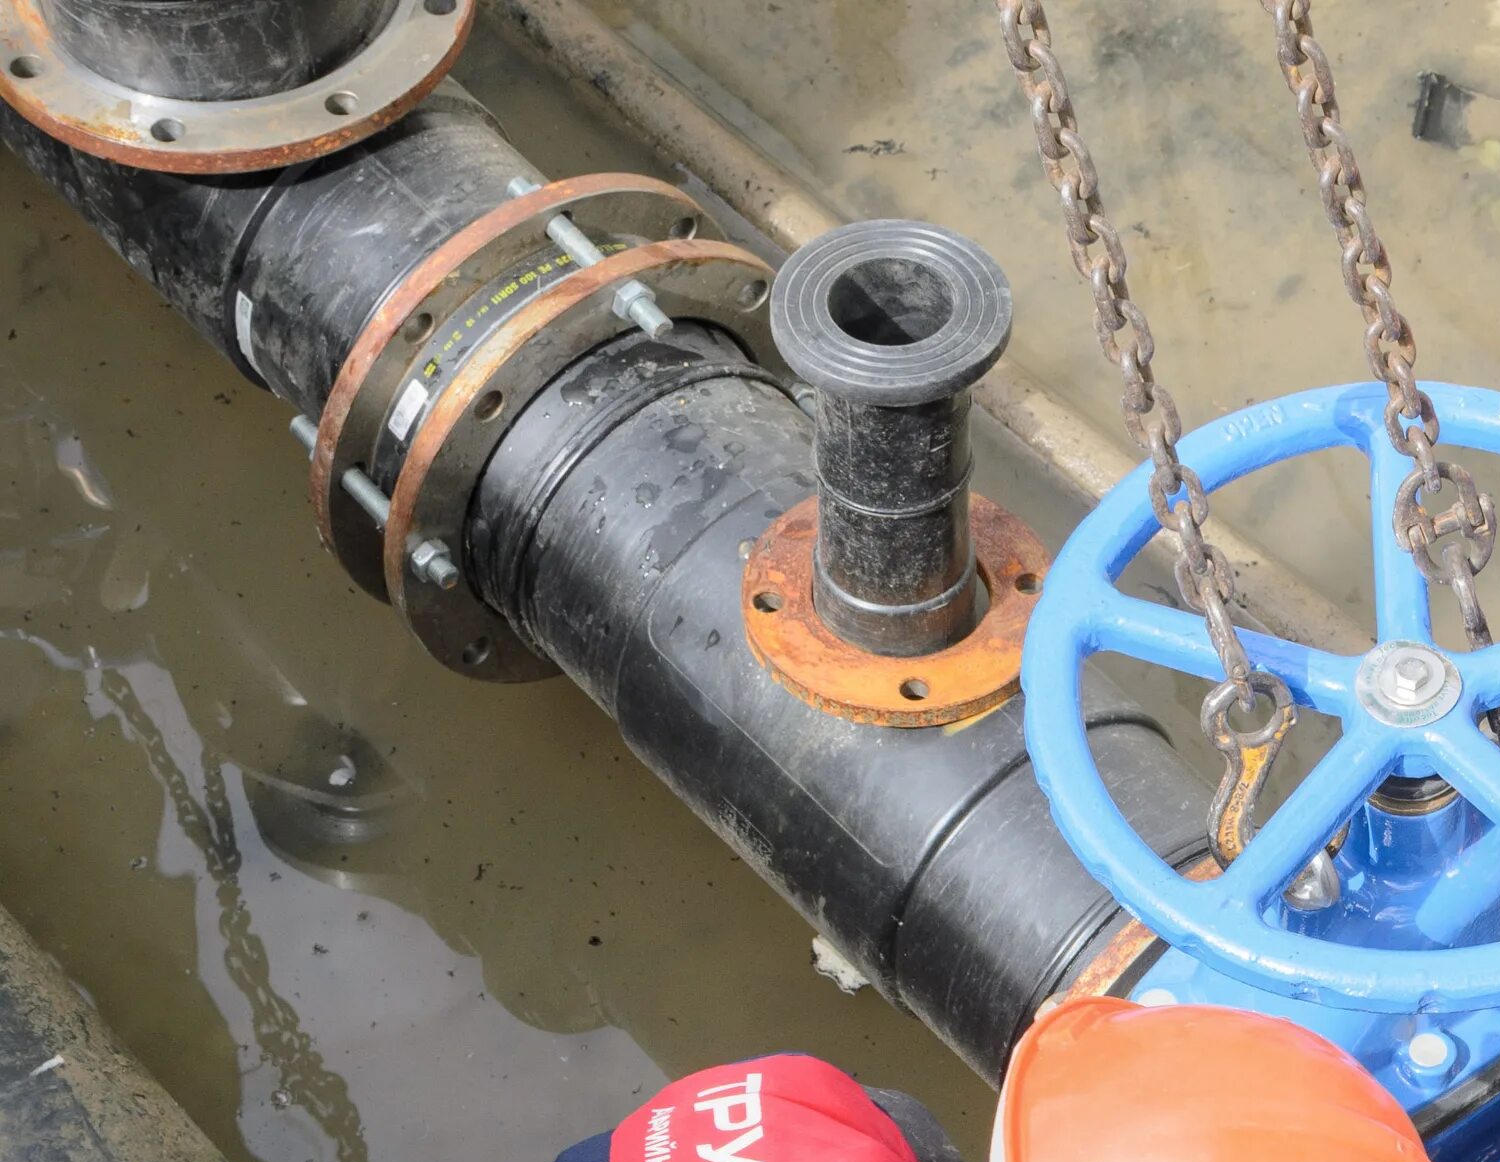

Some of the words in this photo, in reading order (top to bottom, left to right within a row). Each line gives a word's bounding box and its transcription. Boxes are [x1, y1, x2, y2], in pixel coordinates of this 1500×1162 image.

[538, 263, 553, 275] PE
[519, 272, 537, 286] 100
[490, 281, 520, 305] SDR11
